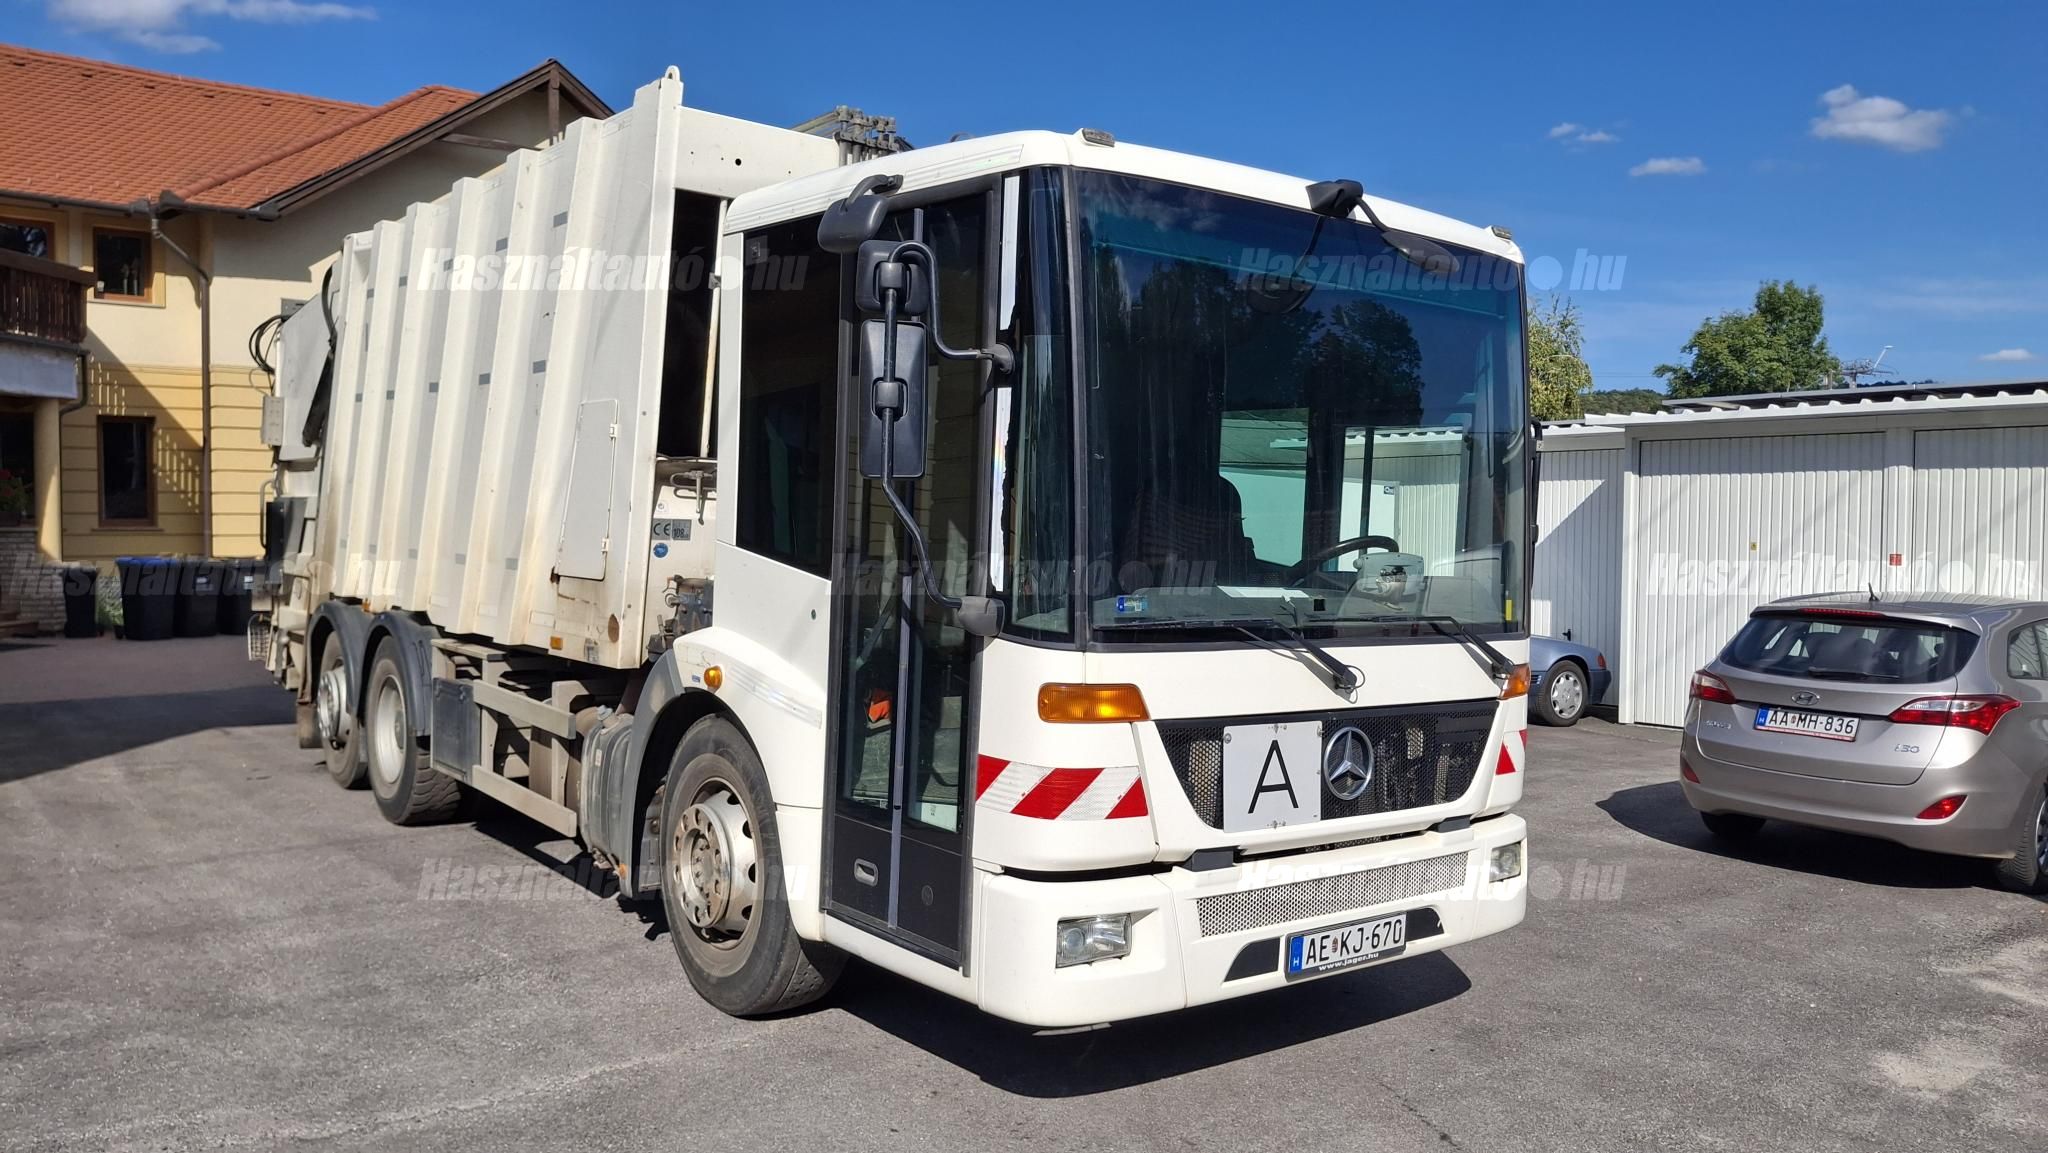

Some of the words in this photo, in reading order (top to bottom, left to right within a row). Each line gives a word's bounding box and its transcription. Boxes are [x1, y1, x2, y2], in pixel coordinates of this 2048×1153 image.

[1797, 712, 1855, 735] MH-836
[1247, 739, 1299, 815] A
[1306, 935, 1330, 965] AE
[1340, 919, 1402, 957] KJ-670
[1319, 952, 1379, 971] www.jager.hu
